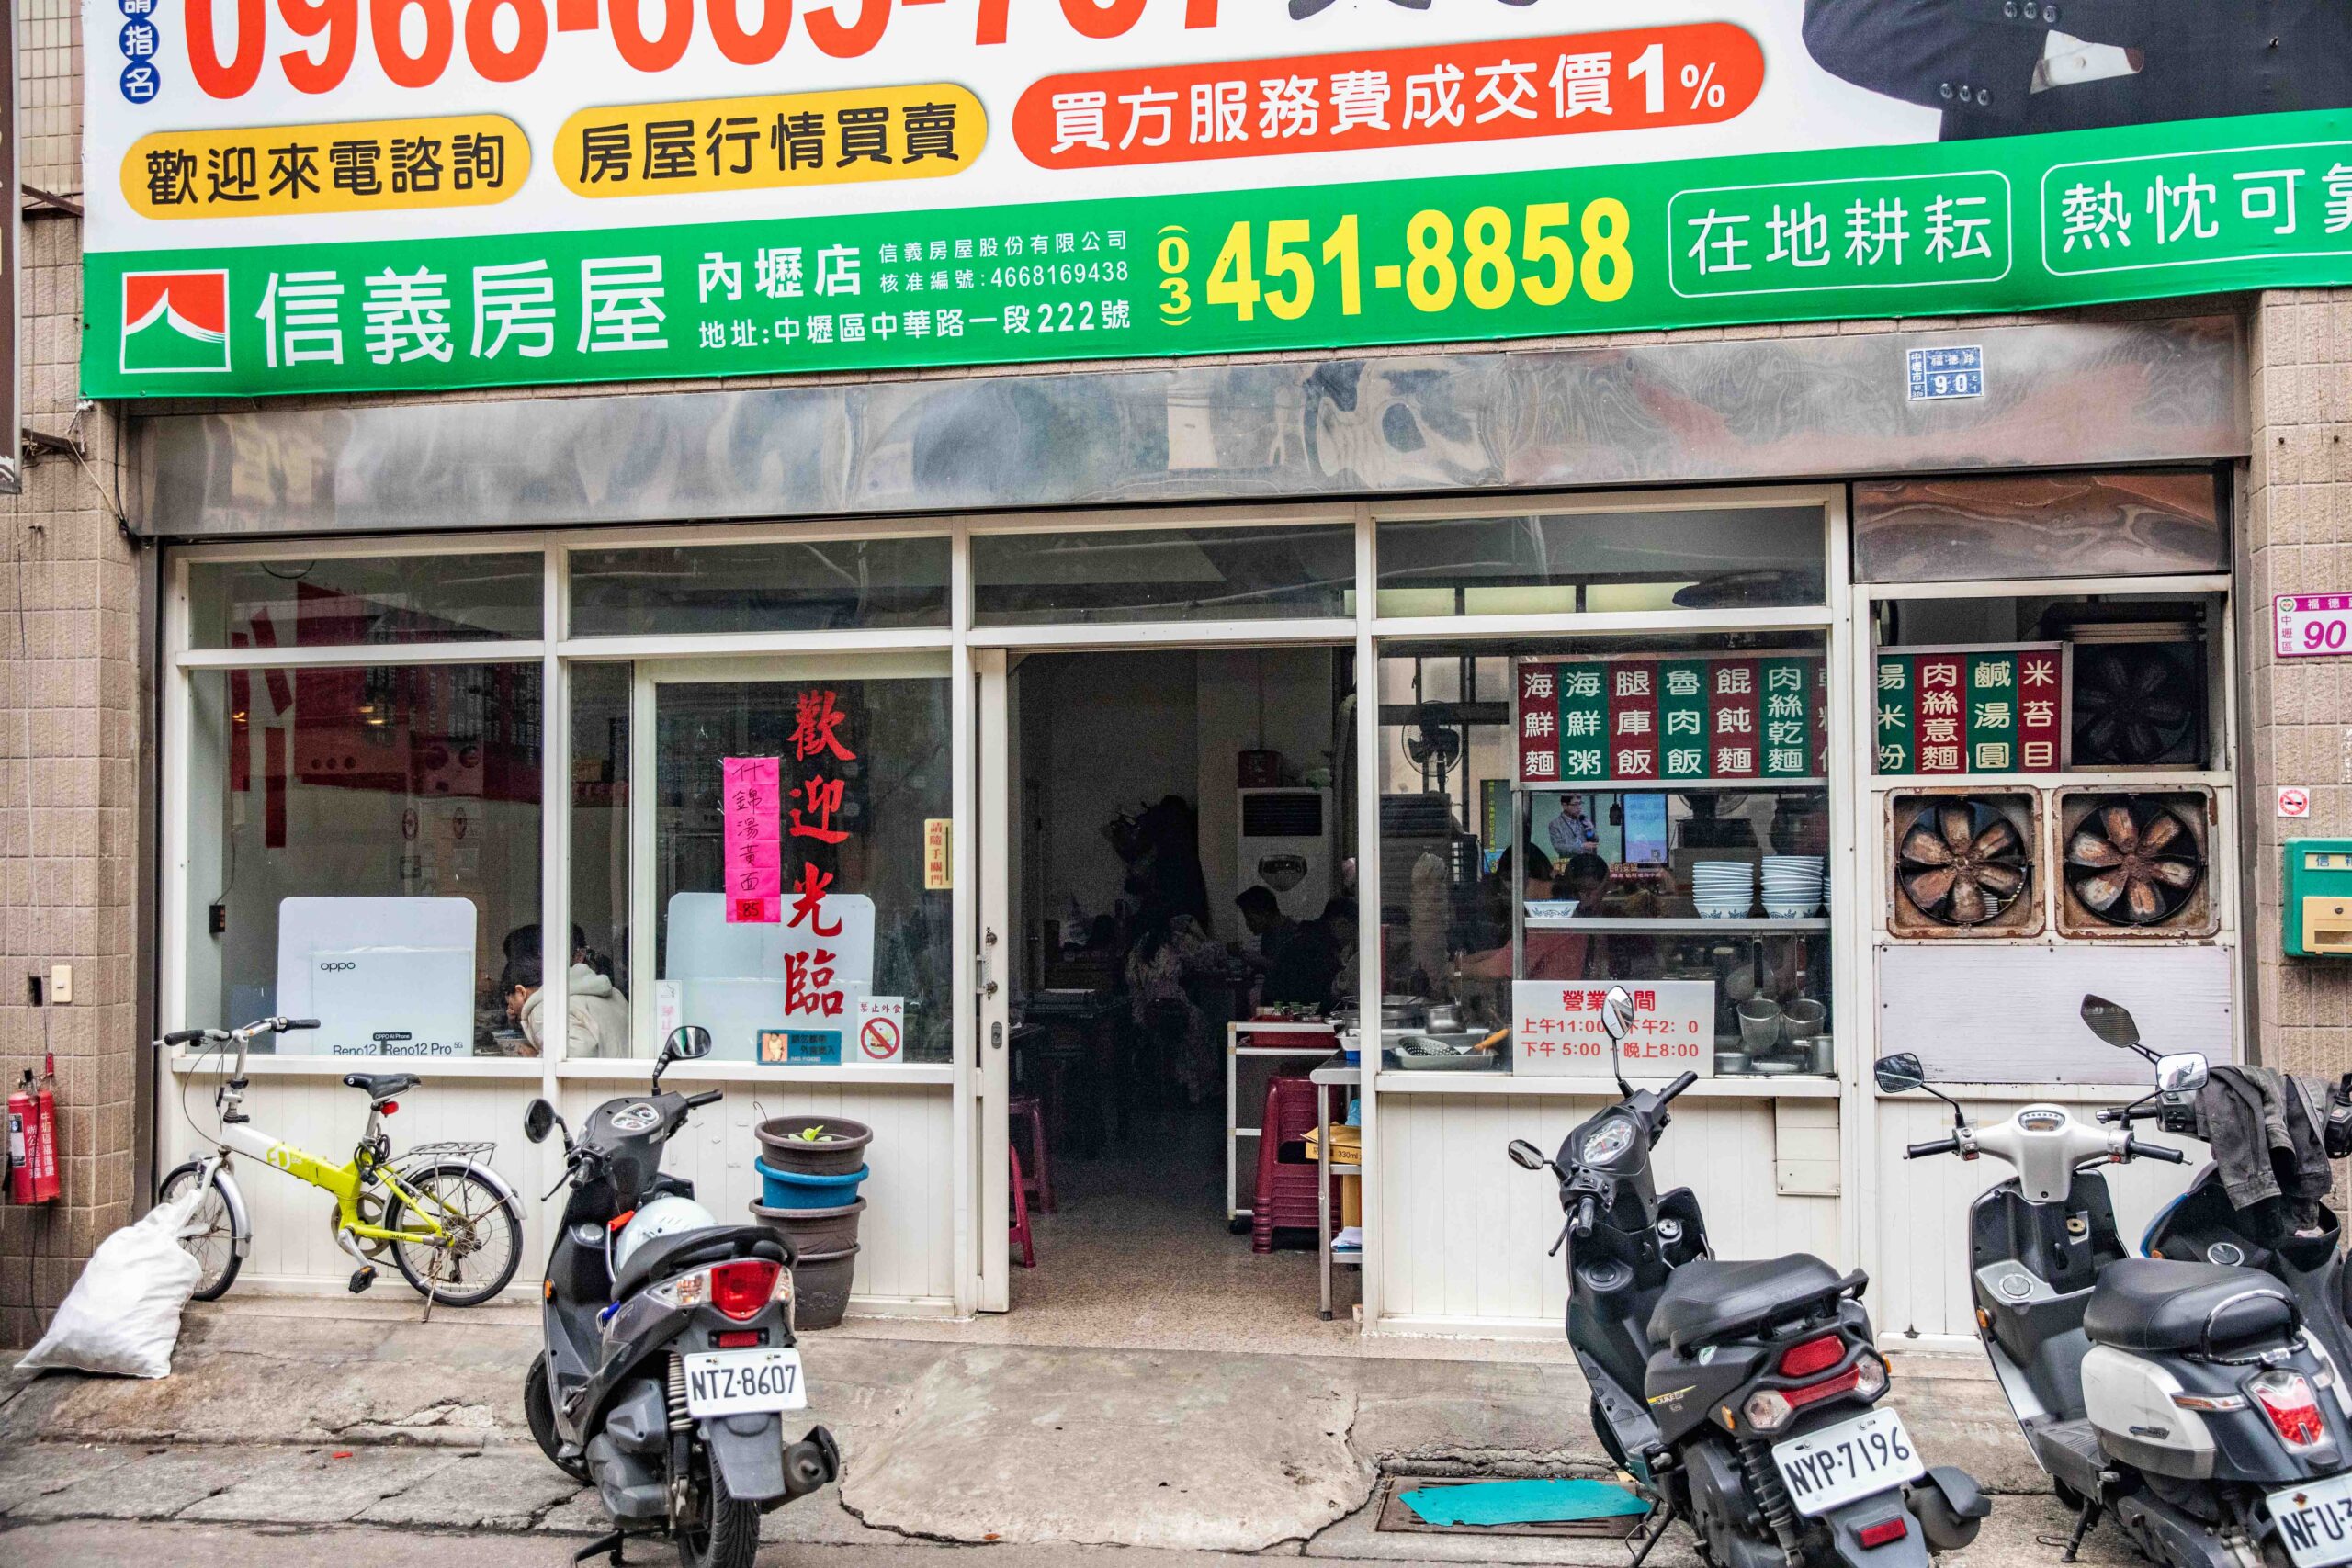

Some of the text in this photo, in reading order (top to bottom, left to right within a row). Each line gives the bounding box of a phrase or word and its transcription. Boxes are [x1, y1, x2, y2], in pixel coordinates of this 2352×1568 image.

[145, 132, 505, 206] 歡迎來電諮詢
[579, 102, 959, 185] 房屋行情買賣
[698, 244, 862, 304] 內壢店
[878, 230, 1128, 265] 信義房屋股份有限公司
[1206, 197, 1634, 322] 451-8858
[1685, 194, 1995, 276] 在地耕耘
[255, 255, 669, 368] 信義房屋
[879, 260, 1129, 294] 核准編號:4668169438
[699, 299, 1132, 350] 地址:中壢區中華路一段222號
[1934, 373, 1968, 394] 90
[2303, 620, 2347, 649] 90
[2307, 597, 2352, 610] 福德
[1524, 672, 1555, 776] 海鮮麵
[1566, 671, 1602, 775] 海鮮粥
[1615, 671, 1652, 775] 腿庫飯
[1666, 670, 1702, 774] 魯肉飯
[1716, 667, 1752, 773] 餛飩麵
[1768, 666, 1804, 773] 肉絲乾麵
[1922, 662, 1959, 771] 肉絲意麵
[1974, 660, 2011, 769] 鹹湯圓
[2023, 660, 2055, 767] 米苔目
[785, 690, 856, 1017] 歡迎光臨
[742, 902, 760, 918] 85
[1562, 989, 1657, 1012] 營業間
[333, 1044, 377, 1055] Reno12
[431, 1043, 452, 1055] Pro
